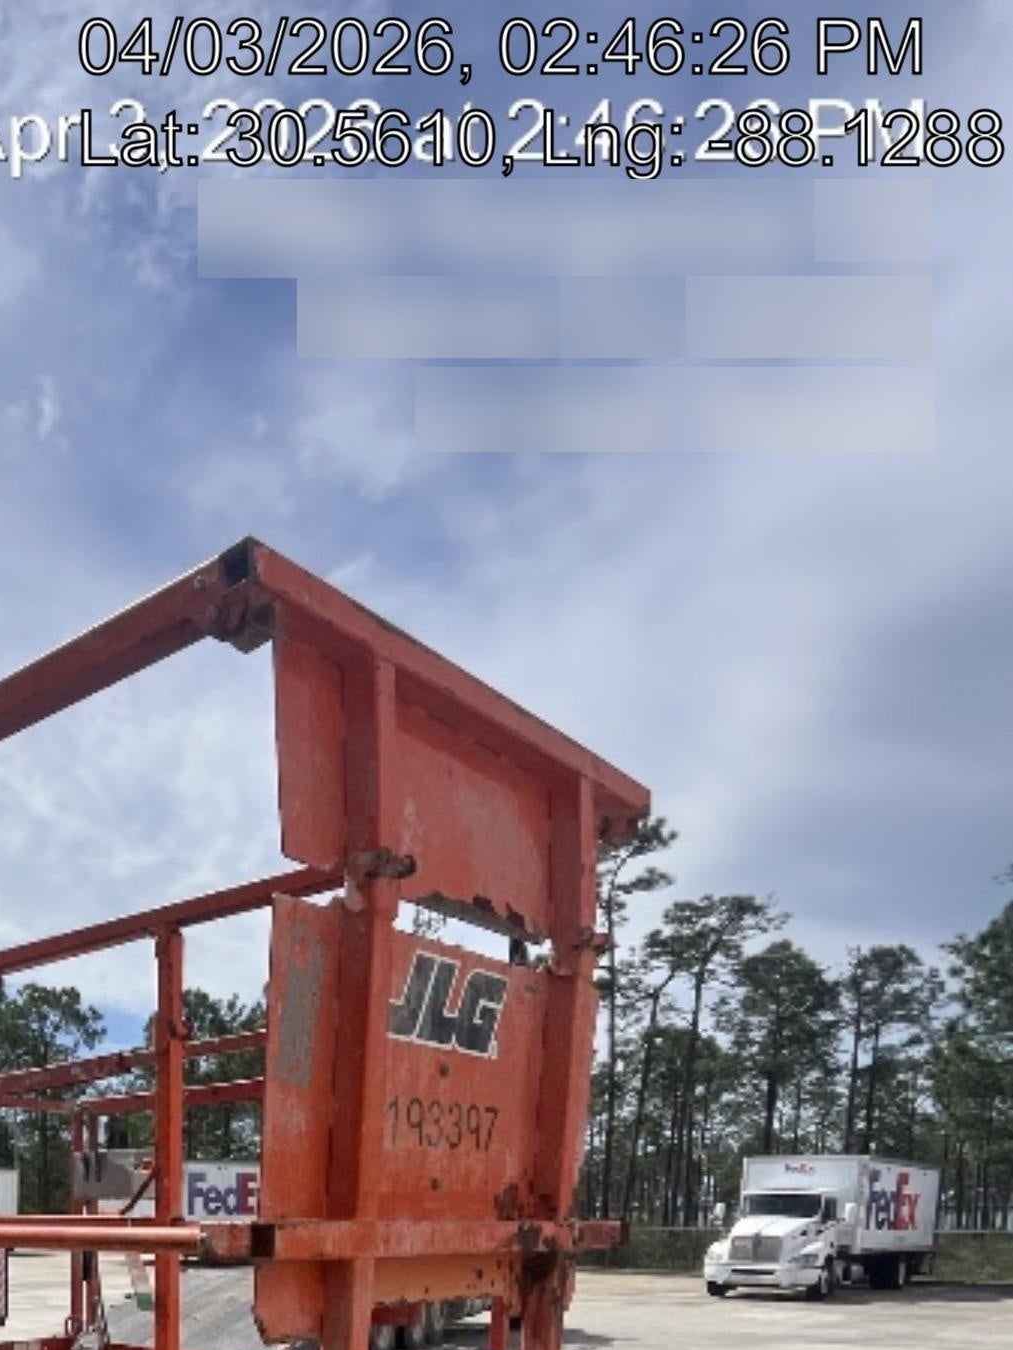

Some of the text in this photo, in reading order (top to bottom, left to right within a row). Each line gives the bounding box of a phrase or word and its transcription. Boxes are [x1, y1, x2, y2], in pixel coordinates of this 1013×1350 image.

[387, 950, 508, 1058] JLG
[389, 1096, 499, 1151] 193397
[188, 1172, 258, 1216] FedE
[866, 1168, 921, 1231] FedEx
